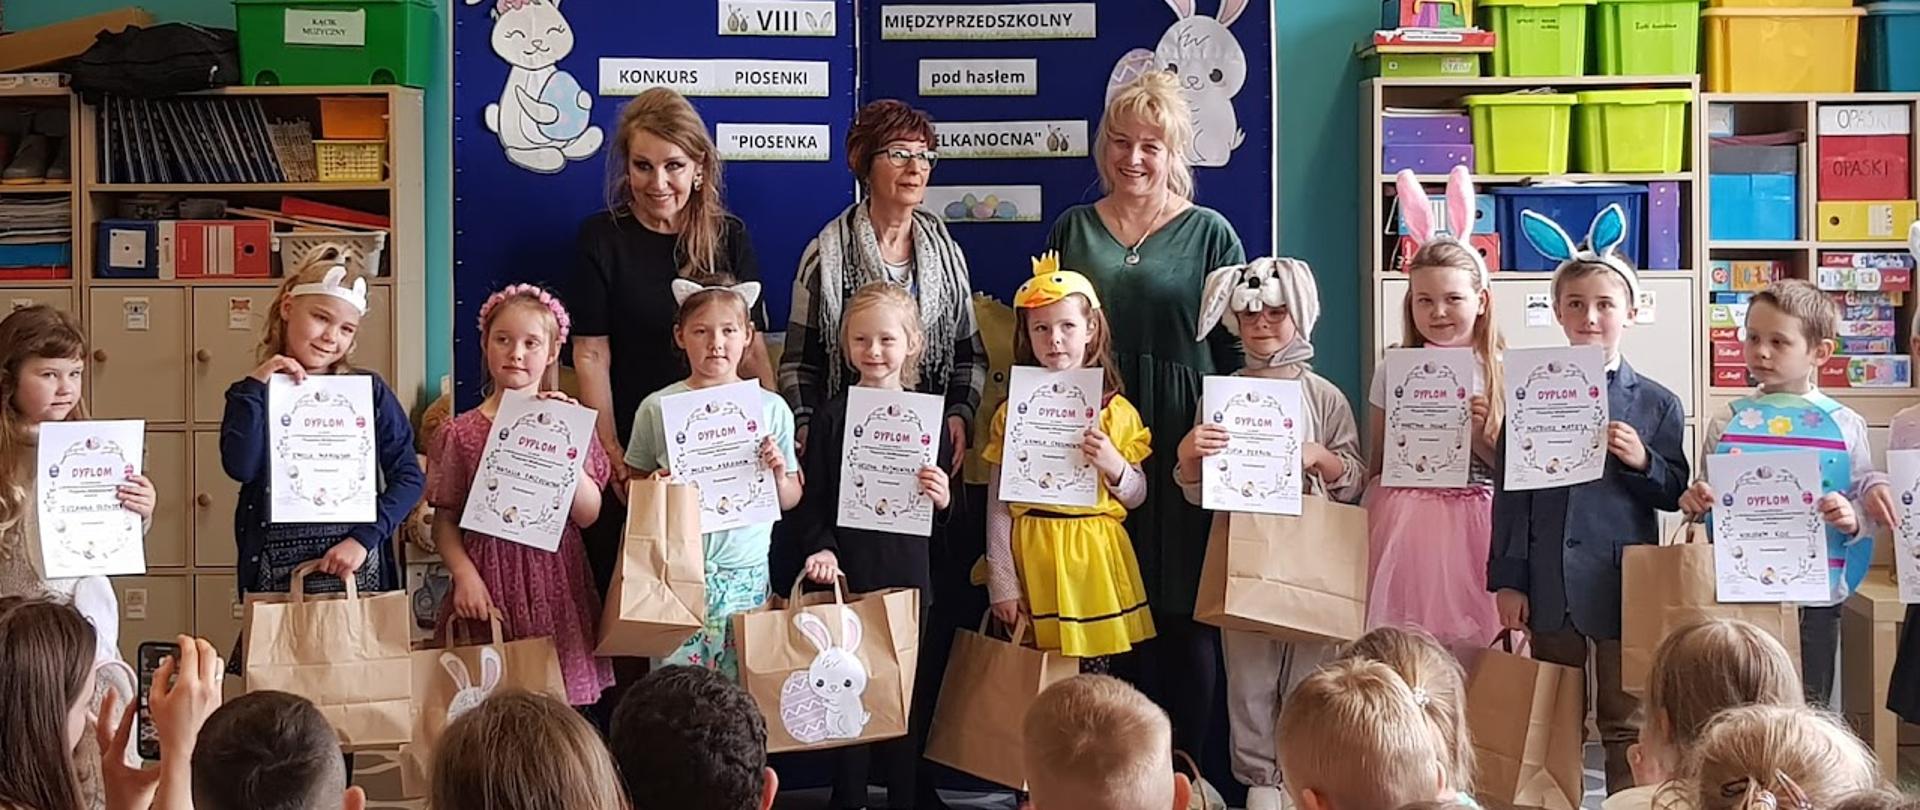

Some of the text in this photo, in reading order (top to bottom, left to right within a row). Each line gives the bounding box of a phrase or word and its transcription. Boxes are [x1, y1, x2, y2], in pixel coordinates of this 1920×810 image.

[757, 10, 798, 31] VIII
[885, 13, 1073, 31] MIĘDZYPRZEDSZKOLNY
[302, 27, 345, 35] MUZYCZNY
[619, 70, 808, 85] KONKURS PIOSENKI
[931, 70, 1025, 87] pod hasłem
[731, 135, 818, 149] "PIOSENKA
[934, 132, 1042, 147] ELKANOCNA"
[1832, 159, 1888, 176] OPASKI
[1413, 389, 1447, 399] DYPLOM
[1538, 389, 1577, 400] DYPLOM
[1039, 407, 1076, 418] DYPLOM
[304, 417, 344, 428] DYPLOM
[1235, 416, 1272, 427] DYPLOM
[698, 426, 736, 440] DYPLOM
[873, 430, 911, 442] DYPLOM
[518, 436, 557, 454] DYPLOM
[72, 467, 113, 479] DYPLOM
[1746, 495, 1790, 506] DYPLOM
